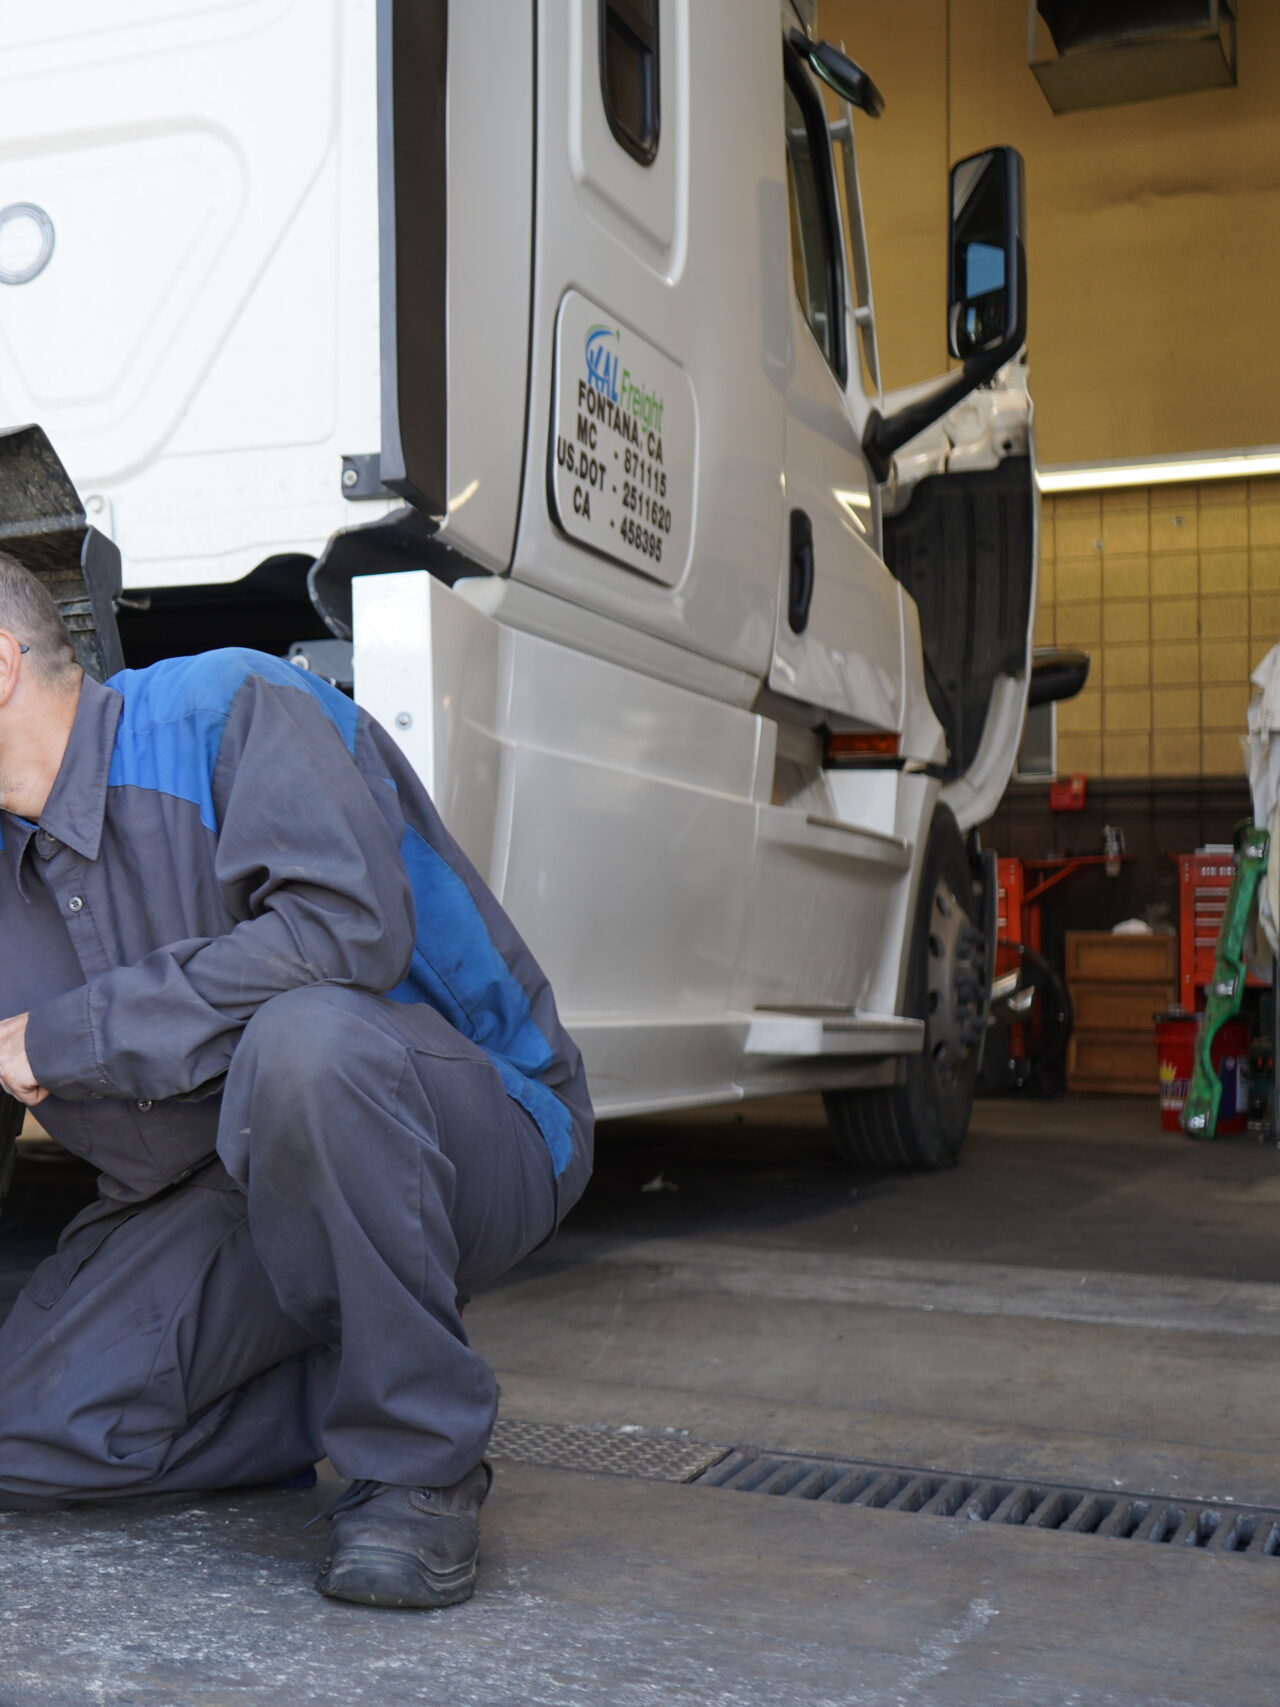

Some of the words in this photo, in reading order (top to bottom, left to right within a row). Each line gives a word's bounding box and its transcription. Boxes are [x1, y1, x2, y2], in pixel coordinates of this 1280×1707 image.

[585, 343, 619, 402] KAL
[619, 367, 664, 432] Freight
[557, 435, 606, 492] US.DOT
[622, 481, 671, 534] 2511620
[577, 412, 598, 451] MC
[624, 447, 667, 498] 871115
[647, 430, 663, 466] CA
[573, 484, 591, 521] CA
[620, 514, 663, 562] 458395
